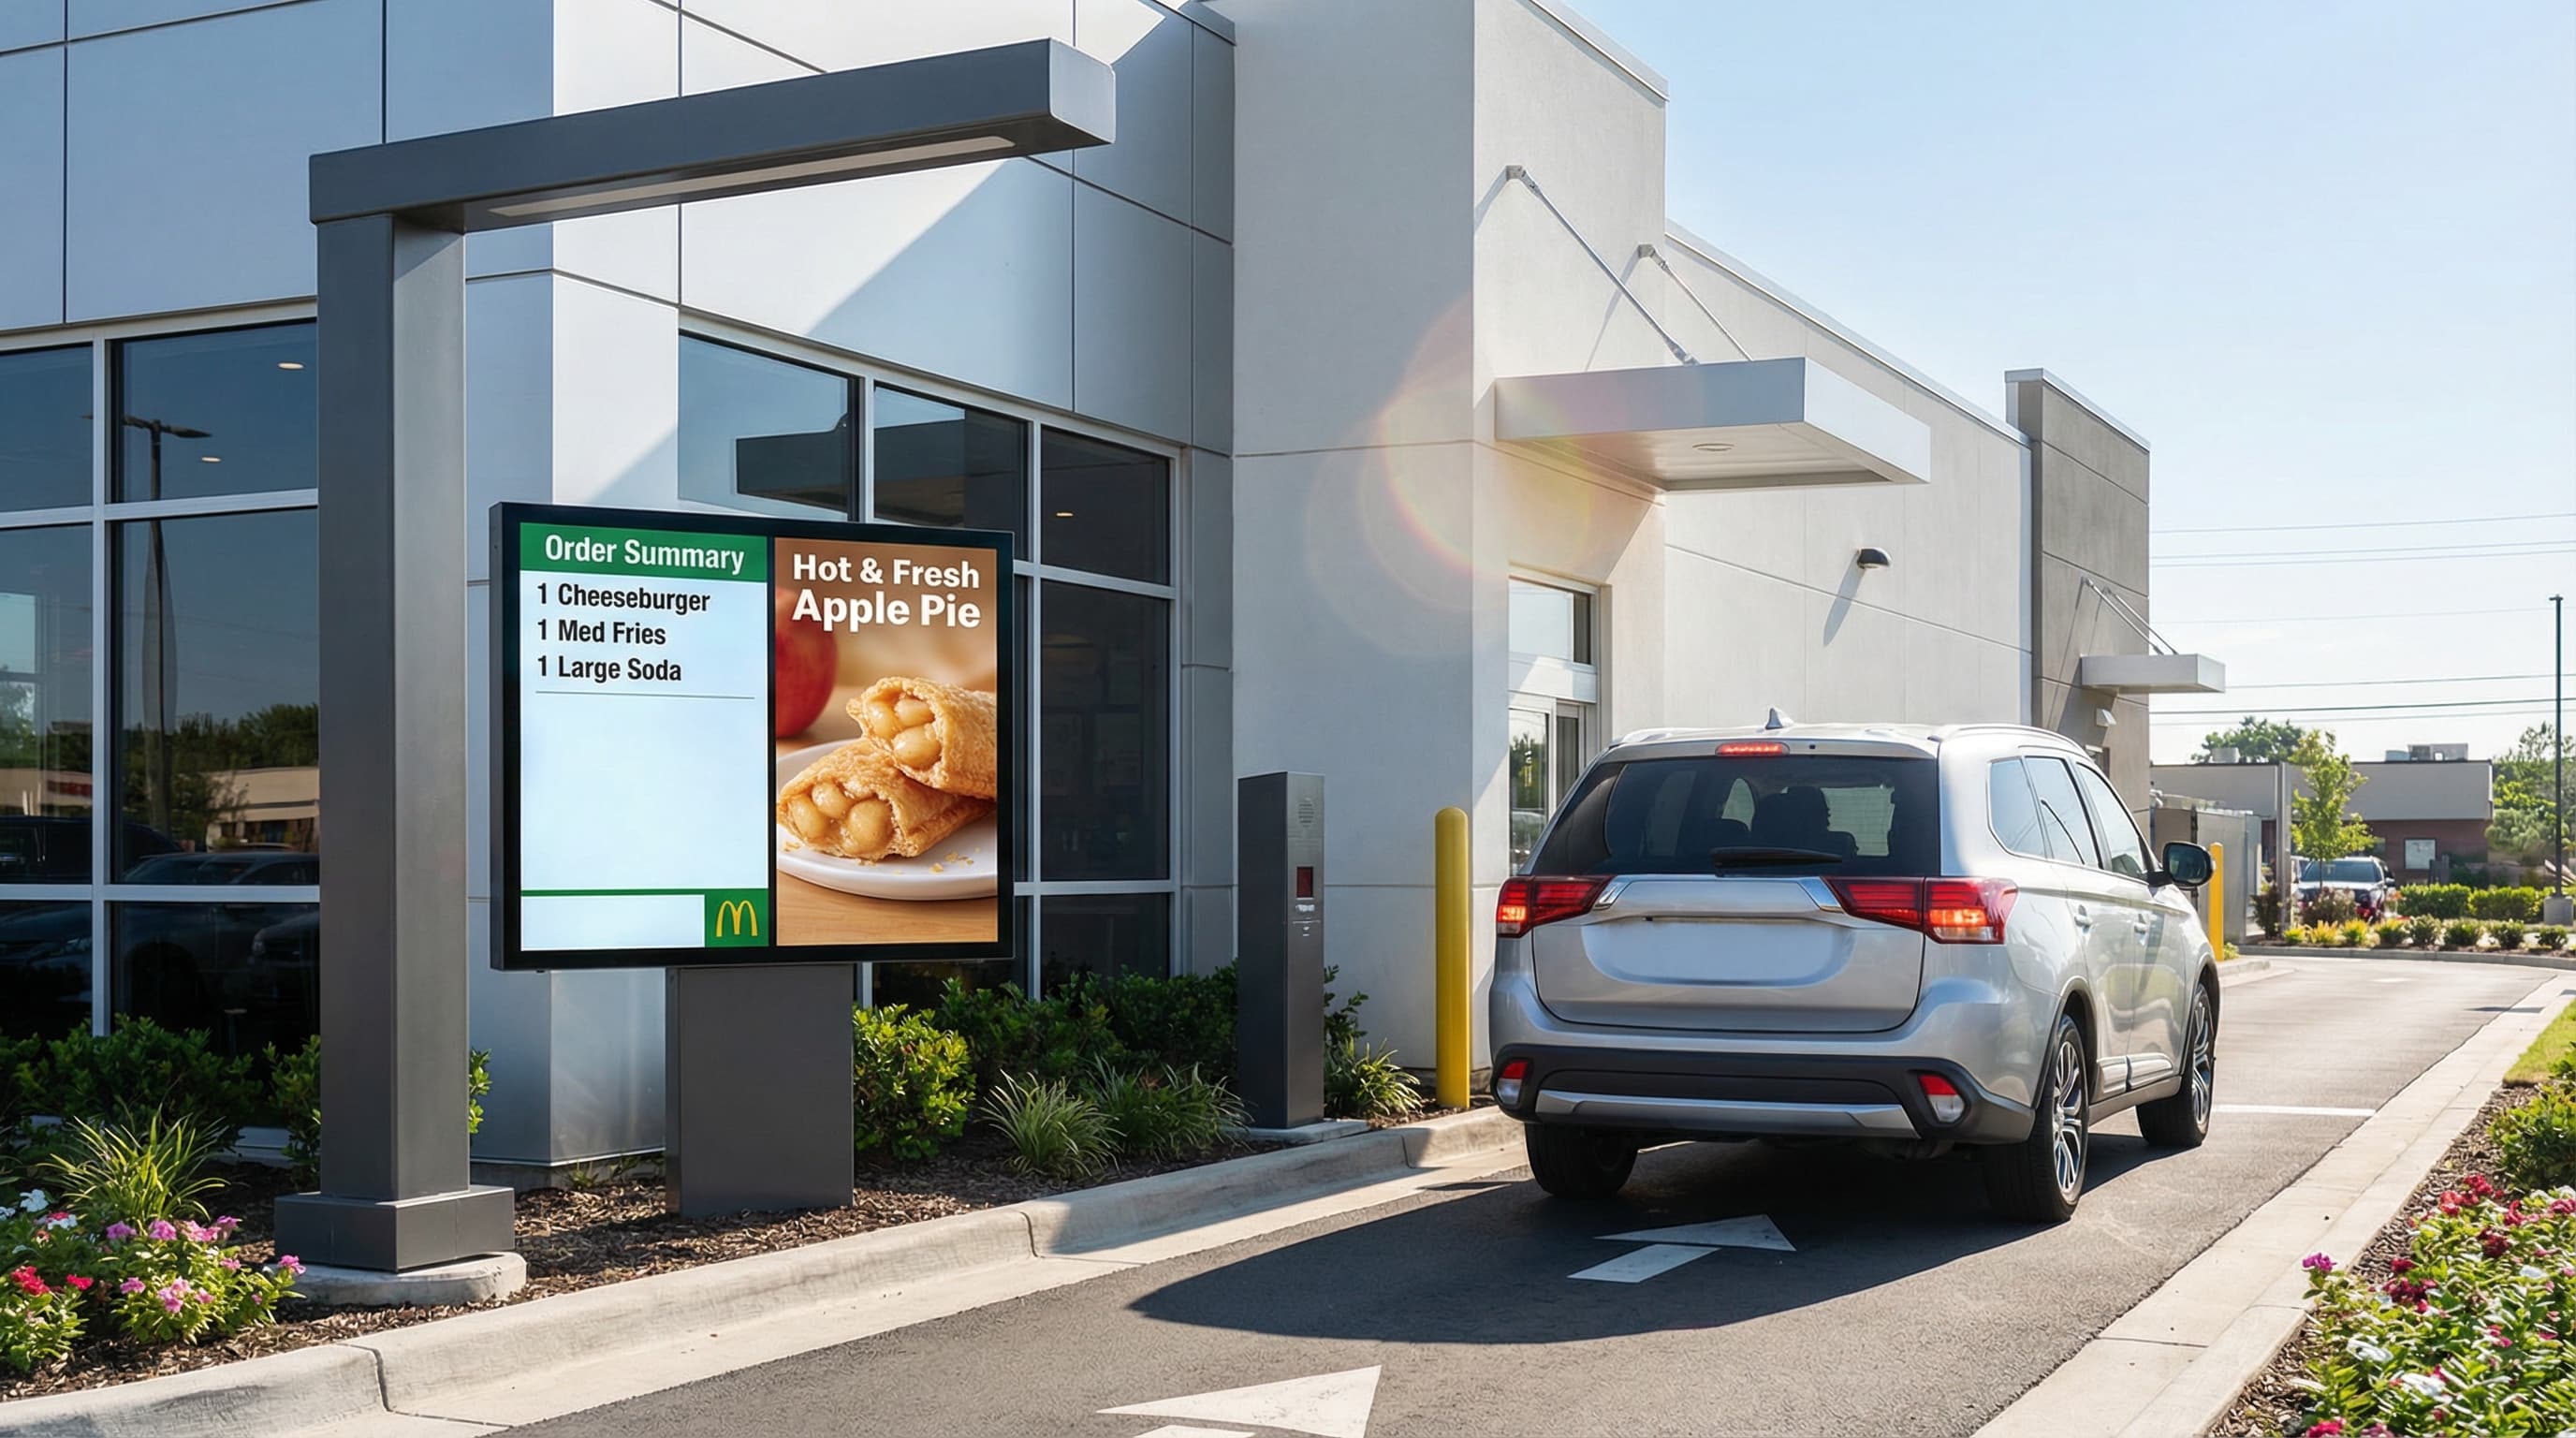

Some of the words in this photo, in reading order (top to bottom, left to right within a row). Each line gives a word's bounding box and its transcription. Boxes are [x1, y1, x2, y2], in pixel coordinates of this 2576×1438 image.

[545, 535, 618, 564] Order
[624, 539, 745, 576] Summary
[793, 553, 852, 582] Hot
[859, 558, 884, 583] &
[893, 559, 980, 588] Fresh
[537, 583, 547, 605] 1
[558, 583, 710, 615] Cheeseburger
[792, 589, 911, 632] Apple
[921, 594, 981, 628] Pie
[537, 619, 547, 640] 1
[558, 620, 605, 643] Med
[613, 622, 666, 645] Fries
[537, 655, 547, 677] 1
[558, 656, 621, 683] Large
[627, 658, 681, 682] Soda
